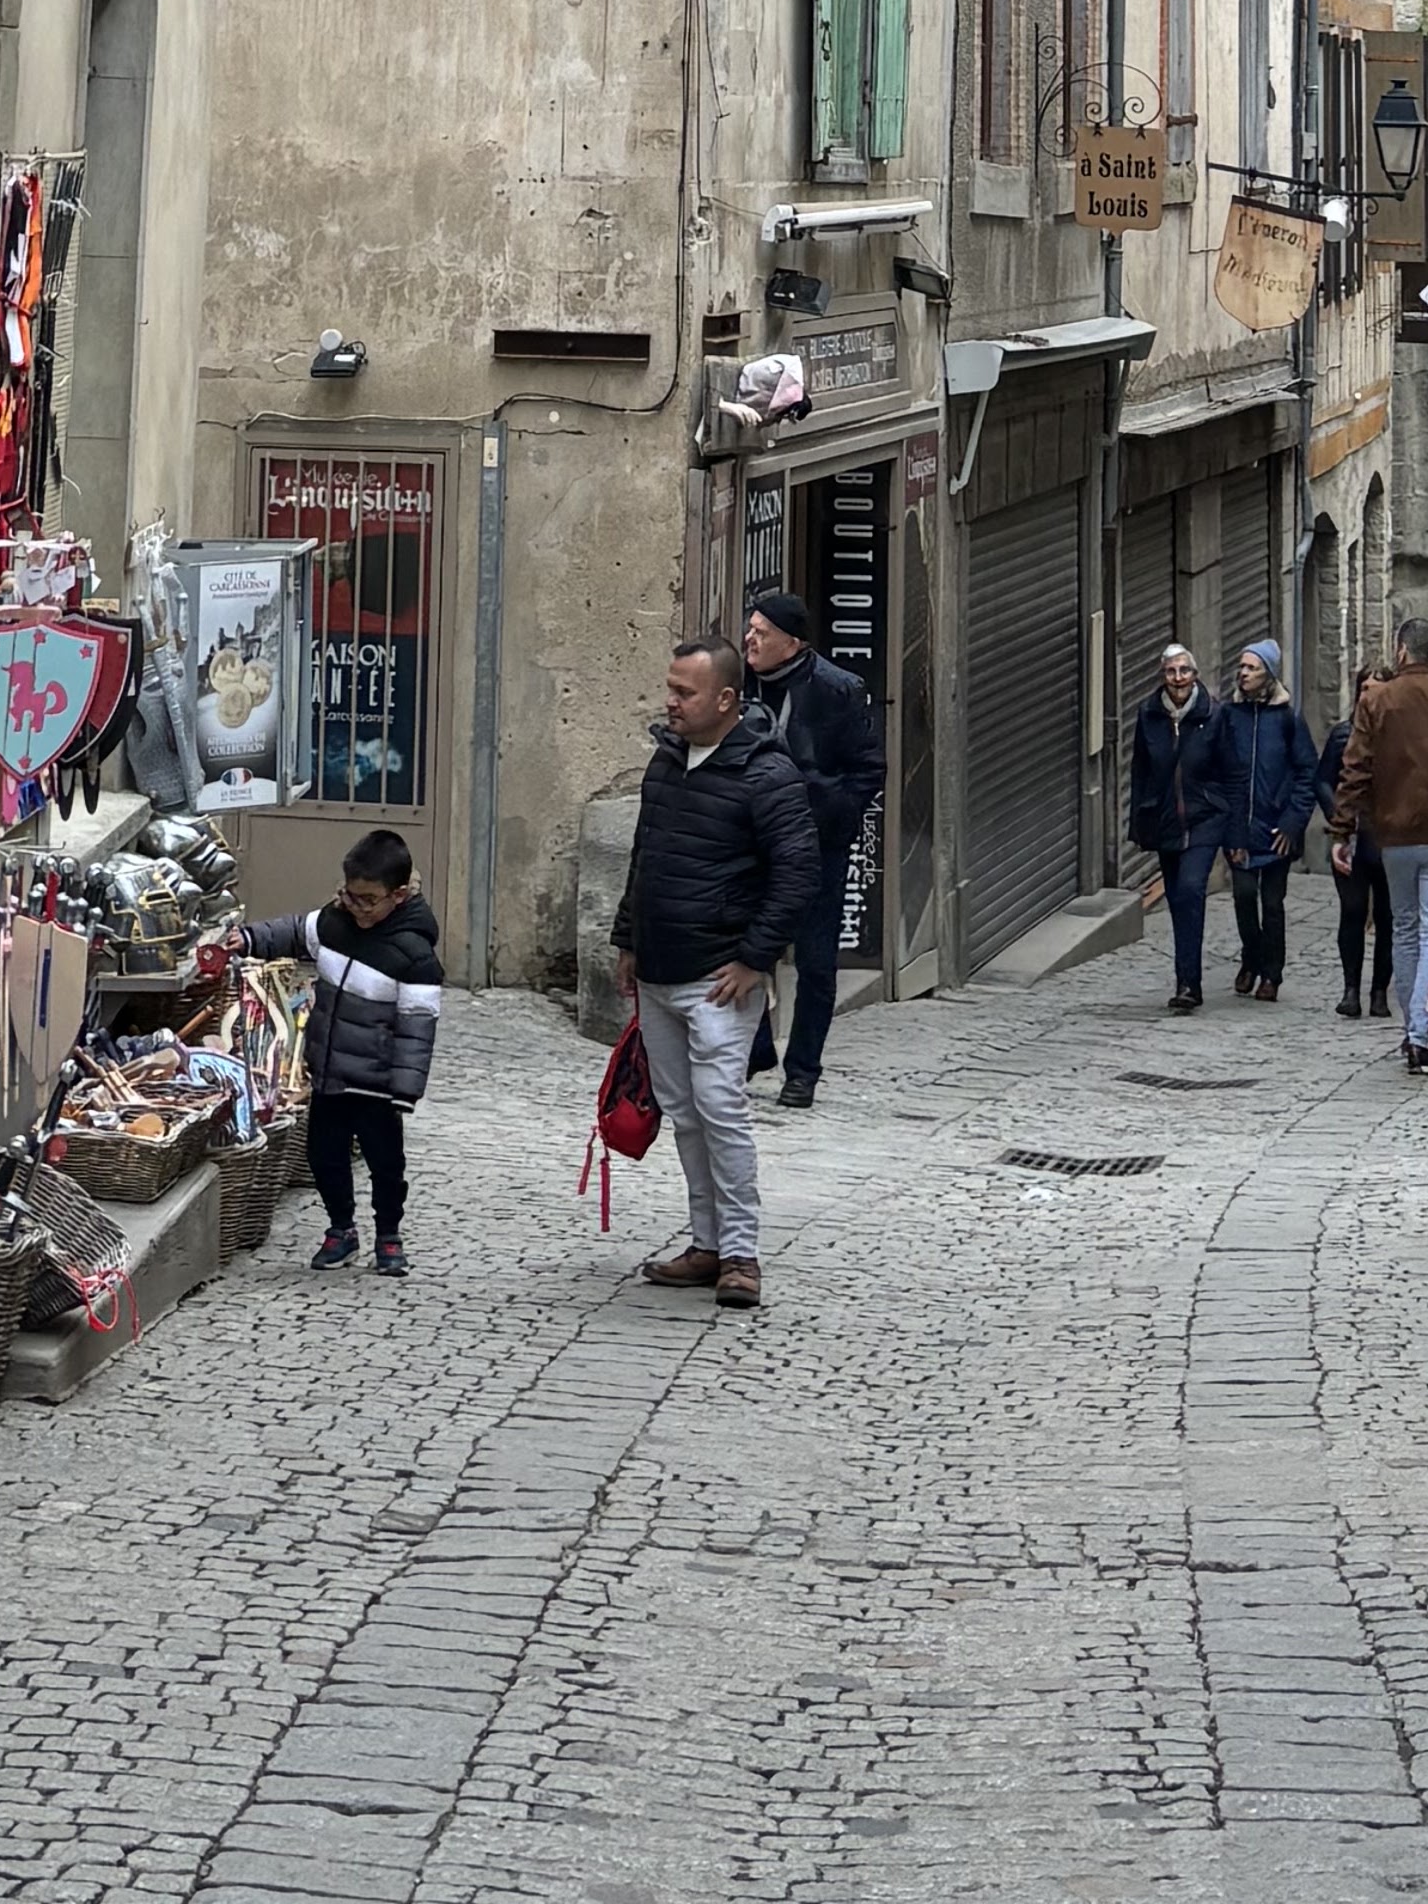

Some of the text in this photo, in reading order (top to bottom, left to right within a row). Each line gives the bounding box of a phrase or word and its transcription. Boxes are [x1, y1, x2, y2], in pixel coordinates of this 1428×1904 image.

[1080, 151, 1158, 181] à Saint
[1087, 190, 1149, 219] Louis
[829, 472, 874, 660] BOUTIQUE
